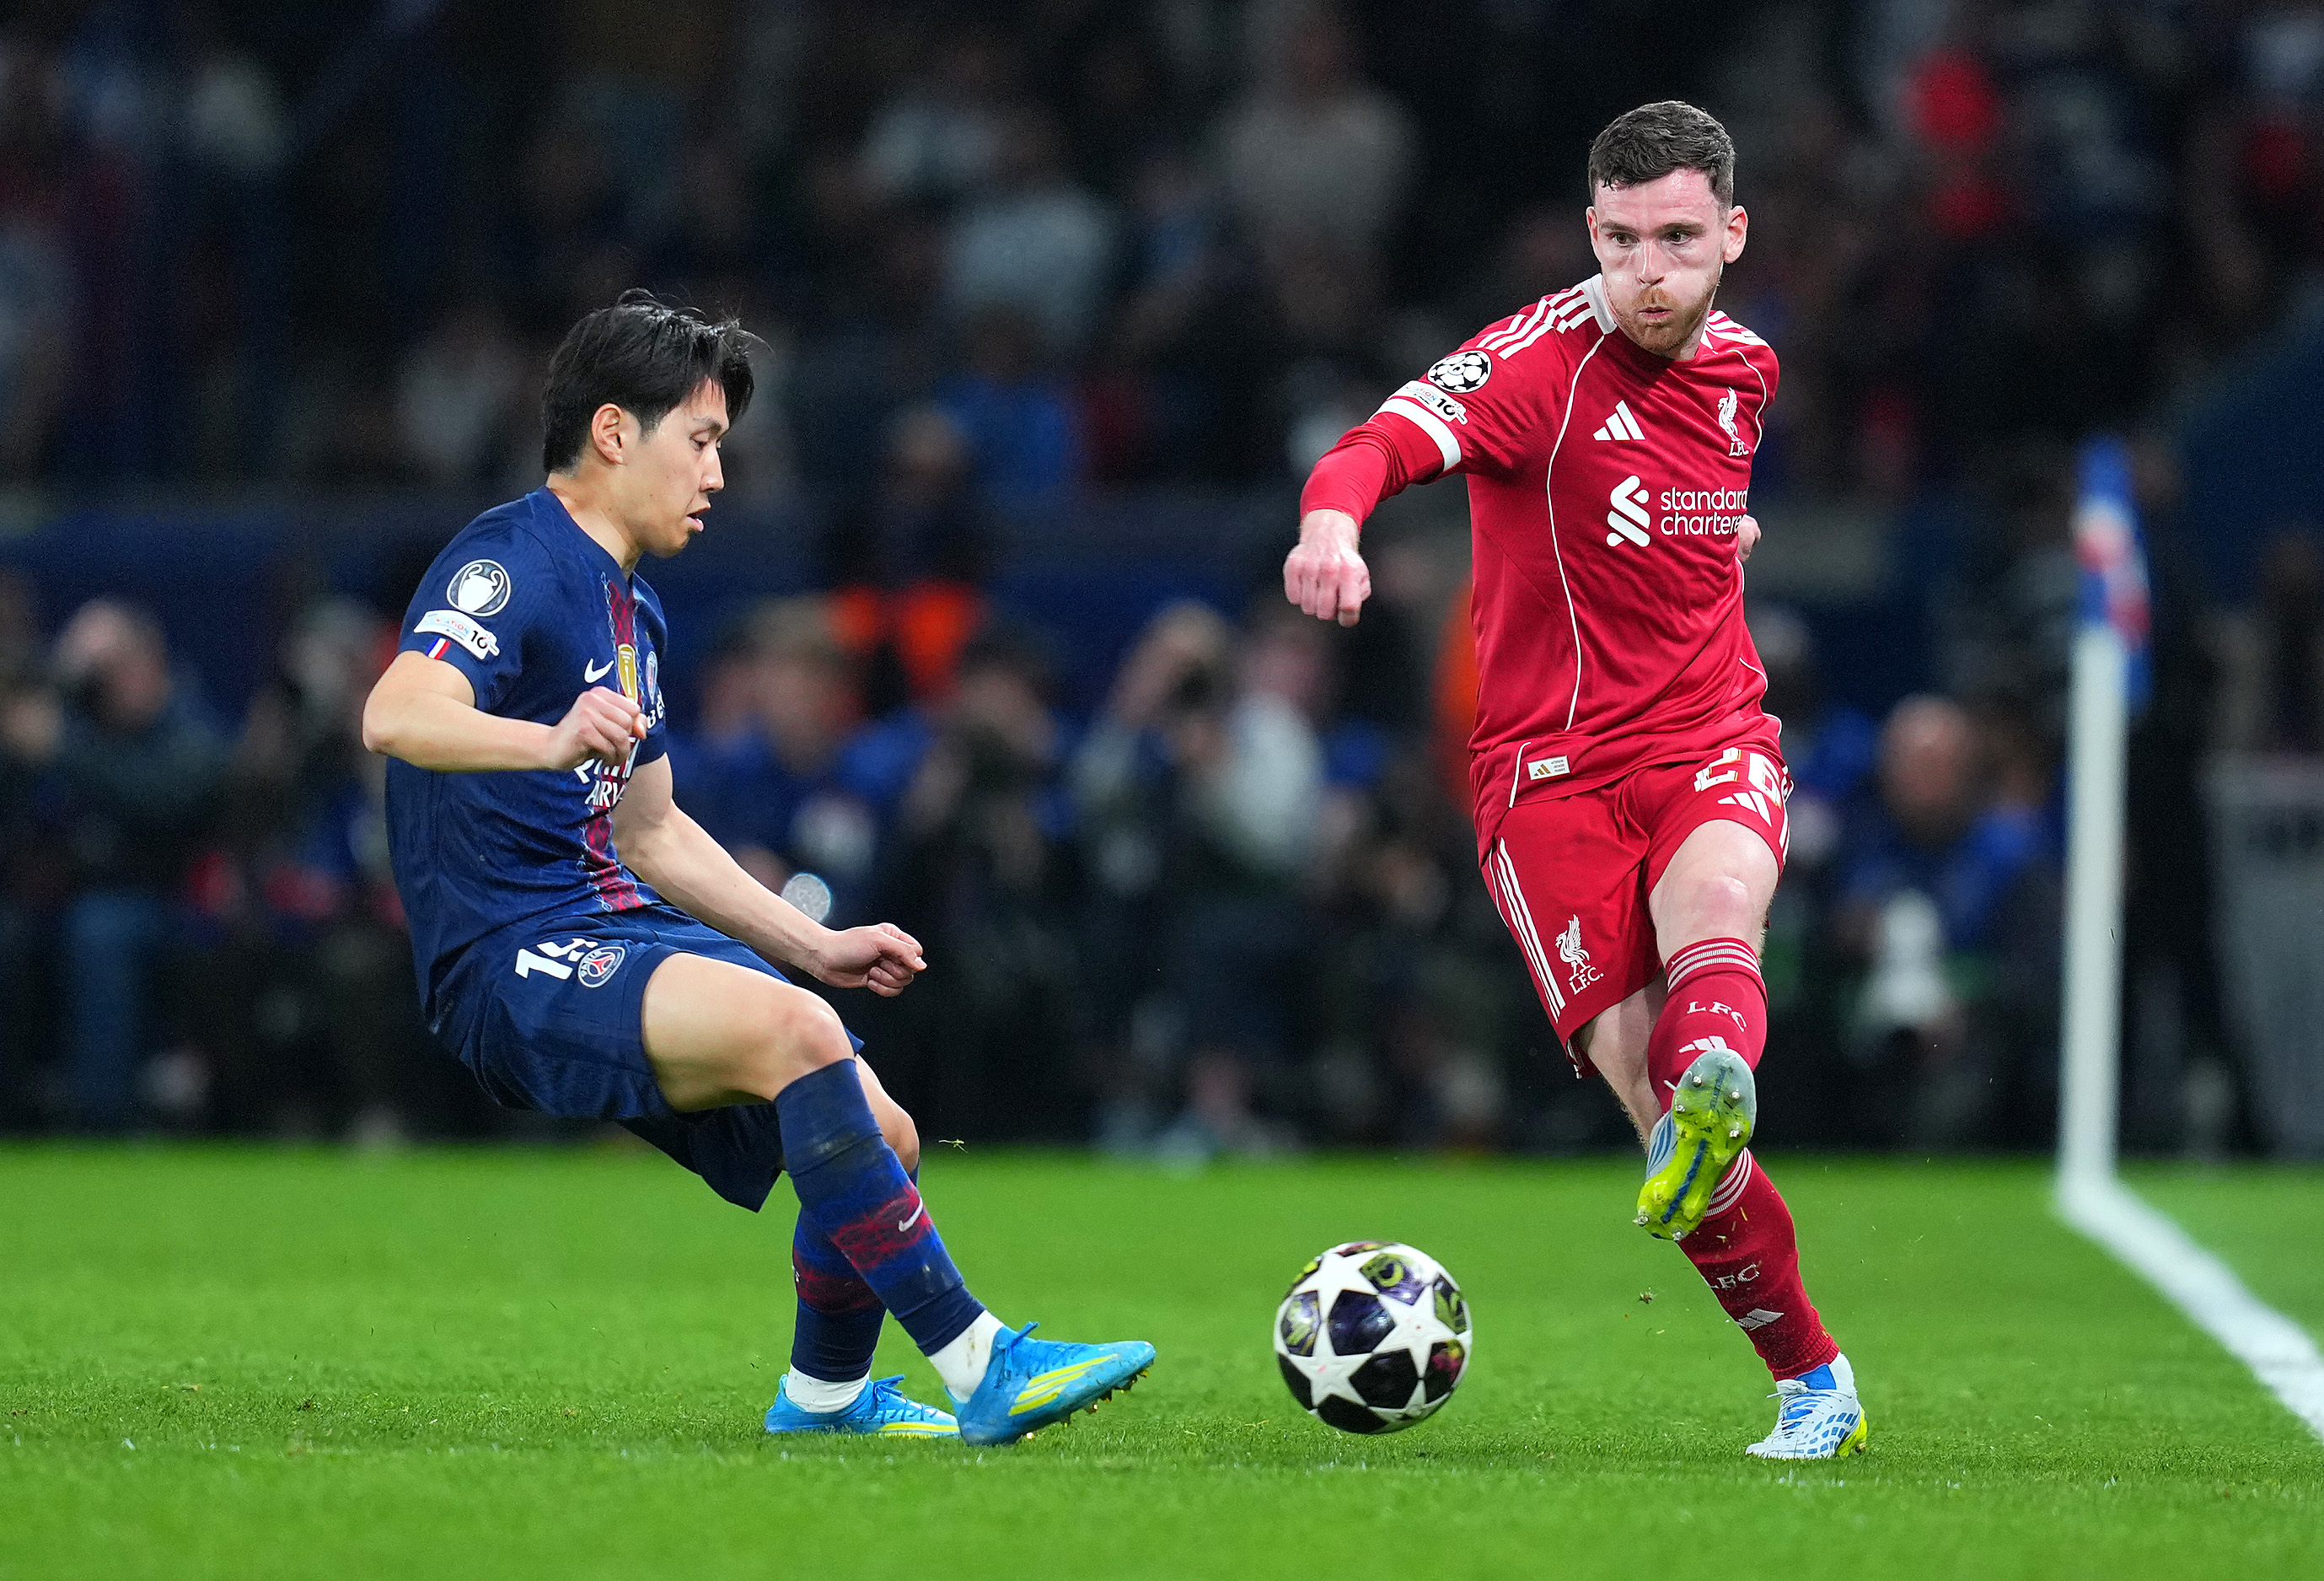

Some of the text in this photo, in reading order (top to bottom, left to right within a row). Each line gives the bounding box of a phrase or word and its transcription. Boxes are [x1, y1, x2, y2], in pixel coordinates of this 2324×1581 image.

[1660, 486, 1749, 511] standard
[1660, 511, 1742, 535] chartere
[1687, 1001, 1747, 1032] LFC
